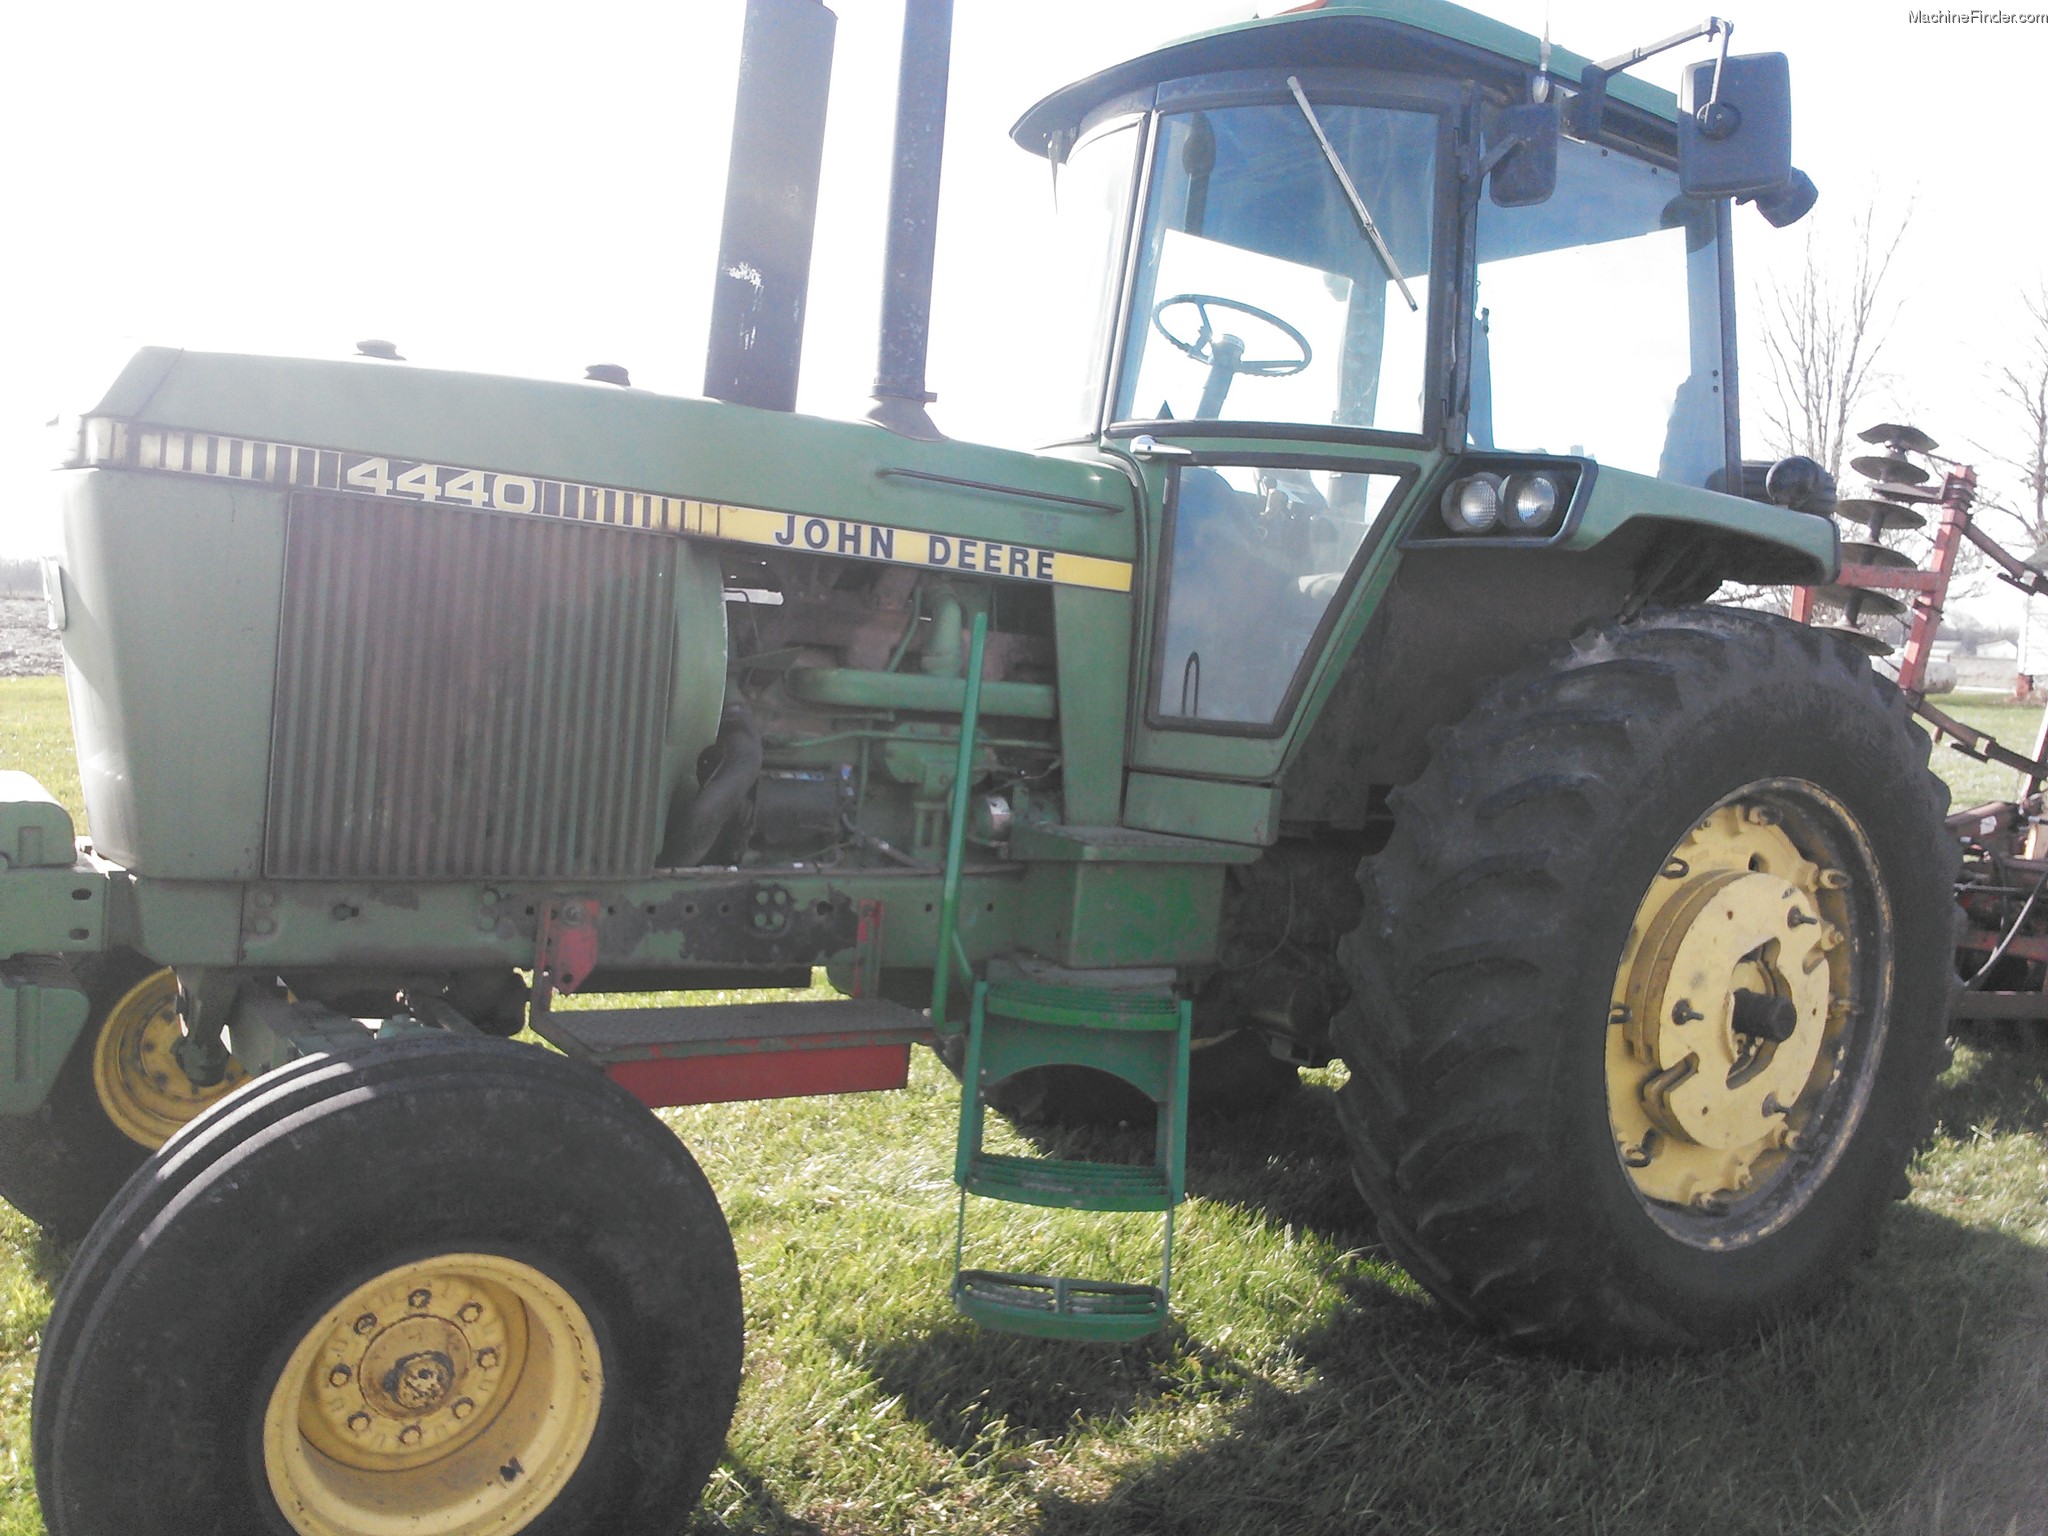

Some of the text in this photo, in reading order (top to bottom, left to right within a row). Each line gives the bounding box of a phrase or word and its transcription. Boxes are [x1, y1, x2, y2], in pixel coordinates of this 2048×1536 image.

[347, 457, 535, 514] 4440
[775, 514, 1055, 581] JOHN DEERE
